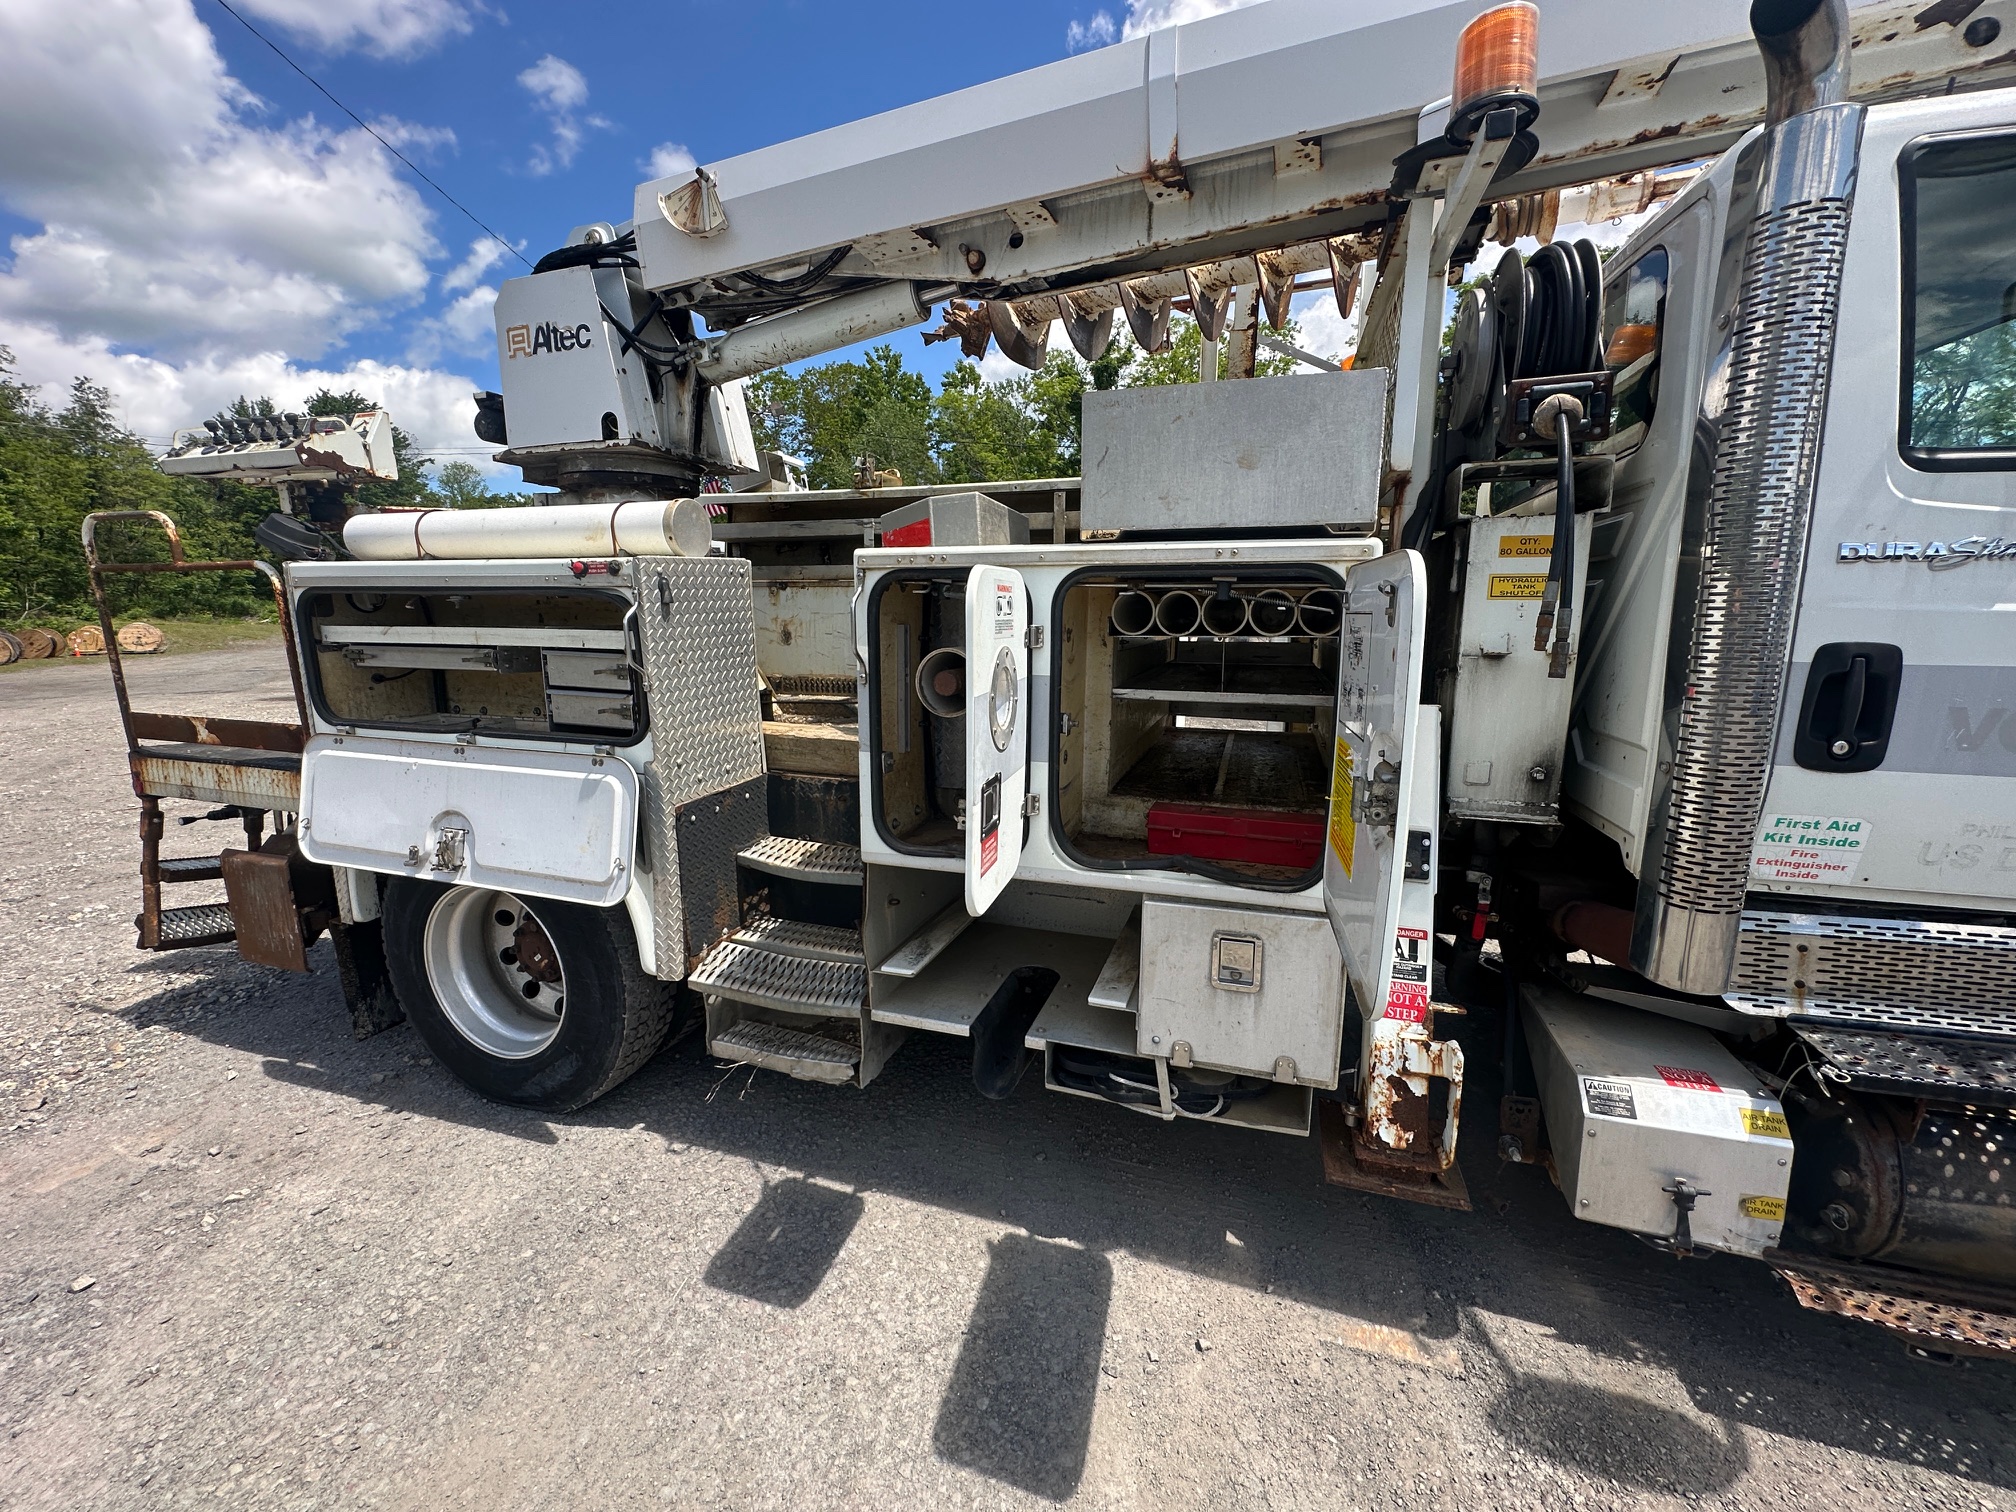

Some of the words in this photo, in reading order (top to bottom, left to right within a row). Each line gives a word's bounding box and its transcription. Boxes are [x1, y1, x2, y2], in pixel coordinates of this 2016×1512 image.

[532, 321, 592, 355] Altec
[1519, 538, 1542, 546] QTY:
[1774, 817, 1821, 830] First
[1826, 820, 1862, 832] Aid
[1763, 832, 1793, 843] Kit
[1798, 834, 1860, 848] Inside
[1790, 849, 1820, 859] Fire
[1756, 857, 1849, 872] Extinguisher
[1775, 869, 1820, 880] Inside
[1397, 929, 1424, 938] DANGER
[1390, 981, 1427, 994] ARNING
[1414, 995, 1425, 1007] A
[1387, 1006, 1419, 1021] STEP
[1597, 1083, 1630, 1094] CAUTION
[1673, 1080, 1711, 1091] STEP
[1742, 1113, 1759, 1122] AIR
[1760, 1115, 1786, 1125] TANK
[1751, 1122, 1782, 1133] DRAIN
[1760, 1200, 1784, 1210] TANK
[1746, 1206, 1777, 1216] DRAIN
